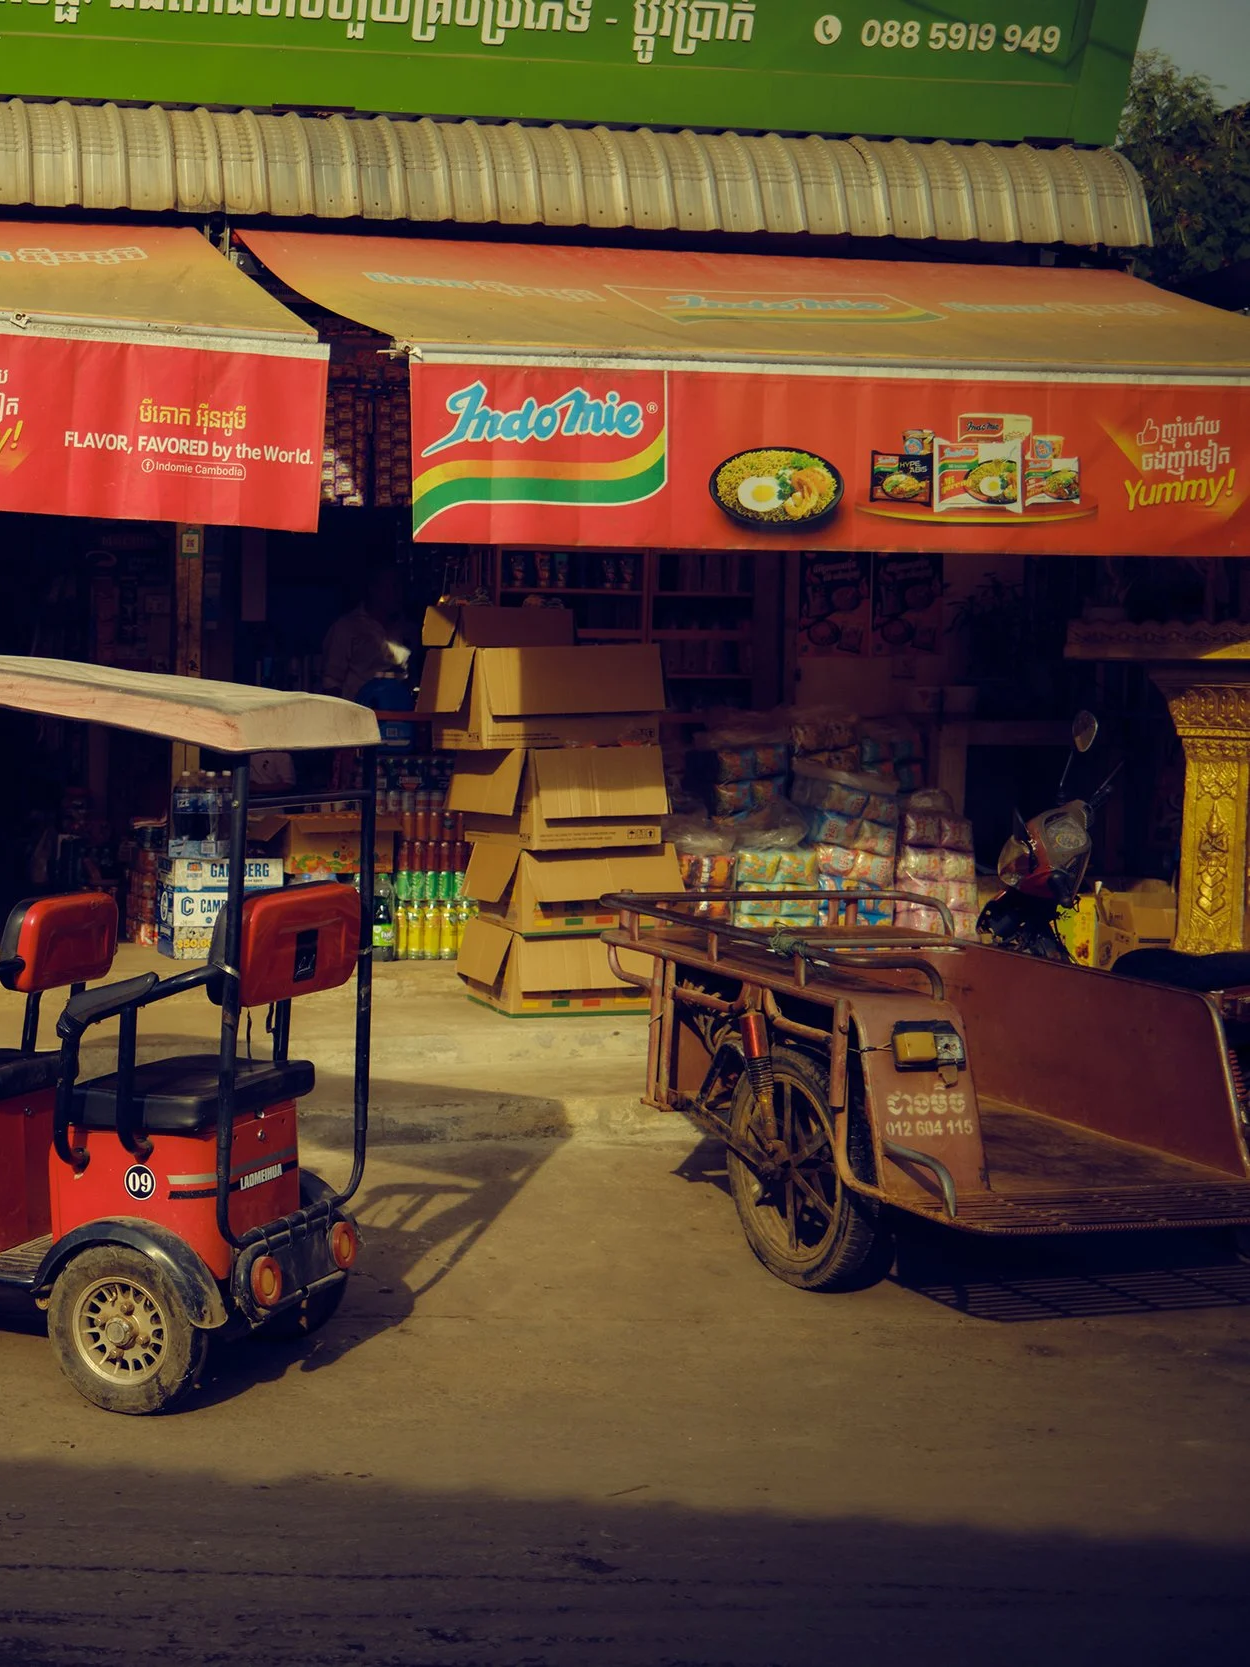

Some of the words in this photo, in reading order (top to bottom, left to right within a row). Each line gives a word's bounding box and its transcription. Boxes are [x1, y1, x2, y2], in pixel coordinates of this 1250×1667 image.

[860, 19, 921, 49] 088
[927, 22, 996, 53] 5919
[1003, 24, 1061, 55] 949
[139, 398, 191, 424] មីគោក
[64, 431, 133, 454] FLAVOR,
[137, 435, 209, 457] FAVORED
[211, 442, 232, 462] by
[235, 443, 262, 460] the
[263, 446, 315, 465] World.
[155, 461, 193, 474] Indomie
[195, 464, 243, 478] Cambodia
[1123, 469, 1236, 511] Yummy!
[886, 1120, 913, 1137] 012
[916, 1119, 944, 1137] 604
[946, 1118, 974, 1136] 115
[127, 1170, 153, 1193] 09
